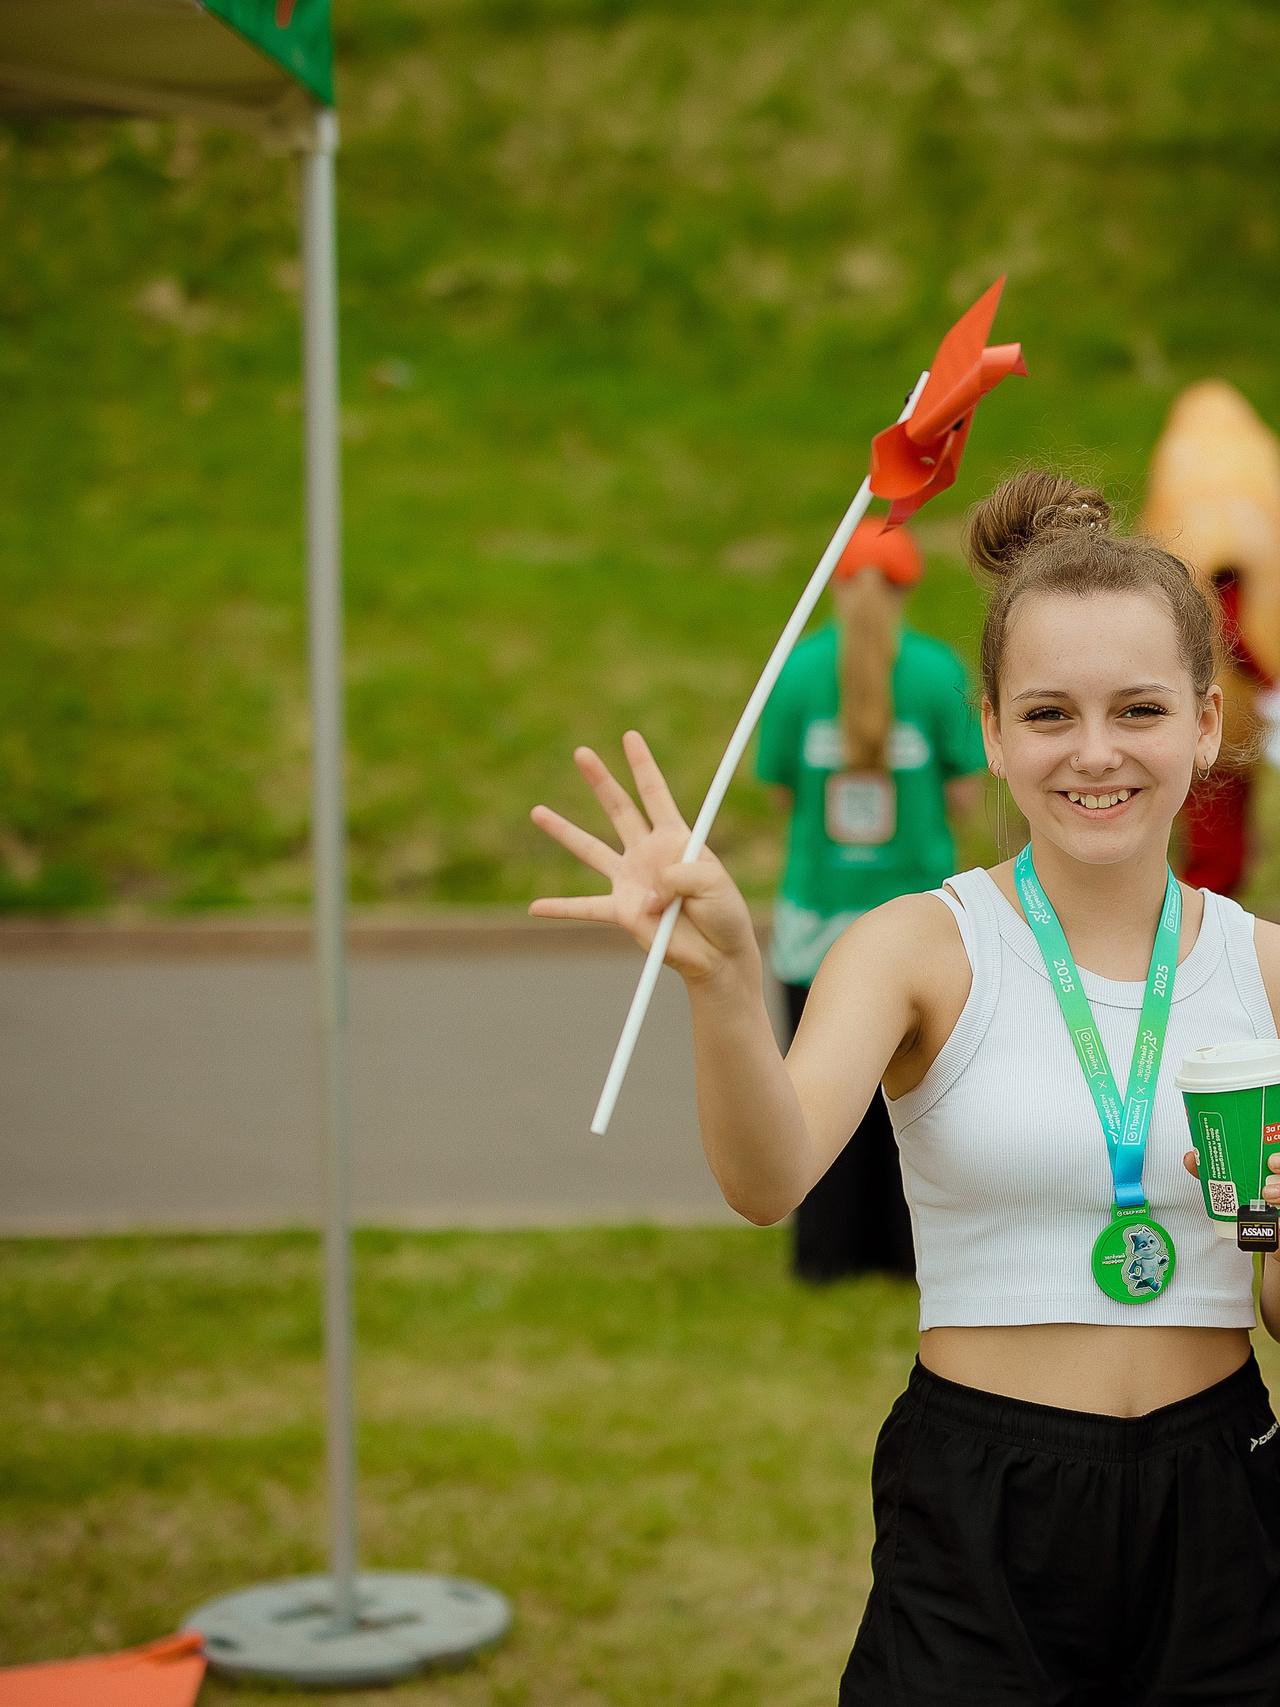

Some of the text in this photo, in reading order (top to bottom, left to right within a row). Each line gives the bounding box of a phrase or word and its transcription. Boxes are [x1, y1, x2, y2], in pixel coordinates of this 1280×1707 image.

[1020, 878, 1035, 909] марафон
[1053, 958, 1075, 993] 2025
[1153, 964, 1169, 997] 2025
[1085, 1042, 1099, 1070] Прайм
[1137, 1045, 1148, 1077] зелёный
[1143, 1050, 1155, 1083] марафон
[1100, 1094, 1115, 1129] марафон
[1130, 1105, 1142, 1131] Прайм
[1242, 1228, 1273, 1236] ASSAND
